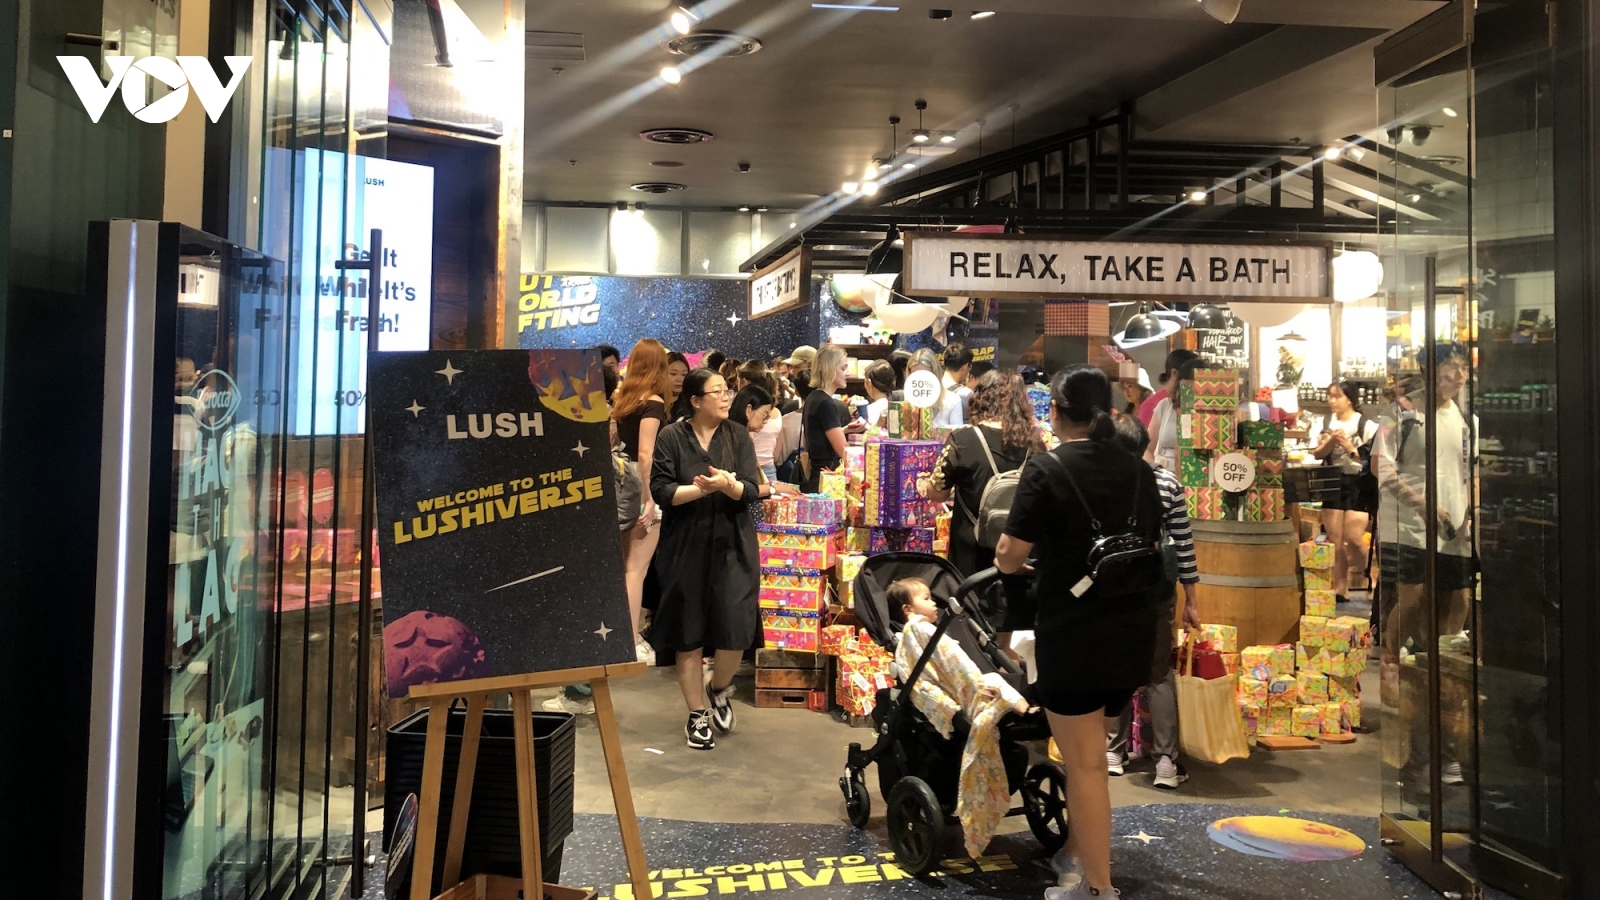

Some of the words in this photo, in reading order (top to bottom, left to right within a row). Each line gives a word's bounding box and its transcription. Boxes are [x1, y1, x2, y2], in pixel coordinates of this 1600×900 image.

[364, 178, 385, 187] USH
[344, 243, 373, 262] Ge
[383, 248, 397, 268] It
[950, 252, 1066, 285] RELAX,
[1084, 255, 1164, 282] TAKE
[1175, 257, 1196, 282] A
[1209, 257, 1290, 284] BATH
[320, 276, 383, 299] Whil
[335, 310, 400, 332] Freh!
[1203, 335, 1229, 348] HAIR
[912, 380, 934, 389] 50%
[912, 389, 932, 398] OFF
[446, 412, 545, 440] LUSH
[1223, 462, 1248, 473] 50%
[1223, 472, 1246, 482] OFF
[417, 483, 504, 513] WELCOME
[510, 477, 534, 492] TO
[539, 468, 573, 486] THE
[394, 475, 603, 545] LUSHIVERSE
[816, 855, 867, 869] TO
